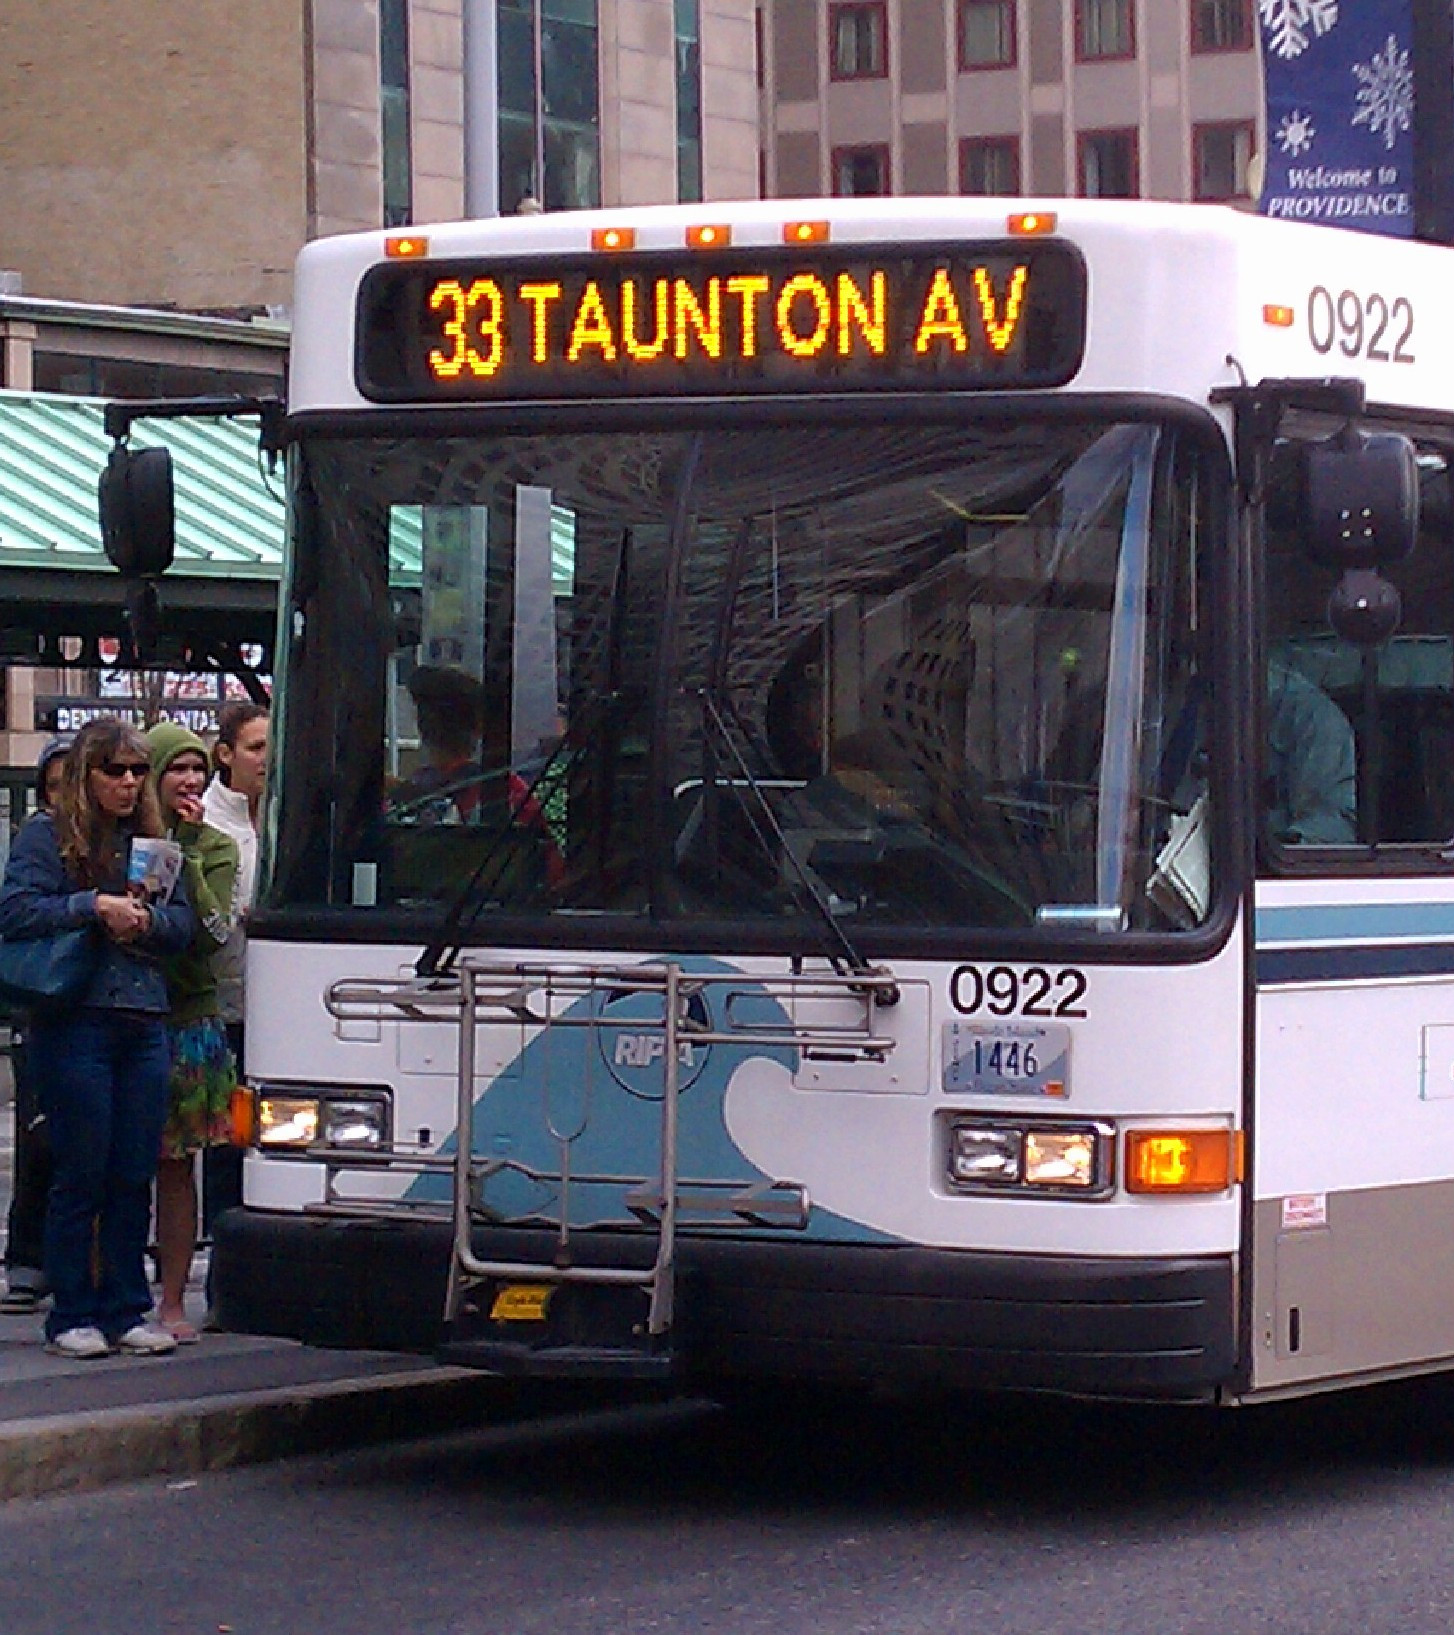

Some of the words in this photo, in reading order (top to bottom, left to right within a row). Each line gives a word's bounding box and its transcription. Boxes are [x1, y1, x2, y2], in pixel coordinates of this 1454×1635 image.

[1287, 168, 1370, 188] Welcome
[1378, 167, 1397, 186] to
[1267, 194, 1411, 218] PROVIDENCE
[429, 280, 503, 376] 33
[520, 271, 884, 362] TAUNTON
[915, 266, 1027, 353] AV
[1307, 285, 1416, 364] 0922
[951, 966, 1087, 1017] 0922
[974, 1040, 1037, 1077] 1446
